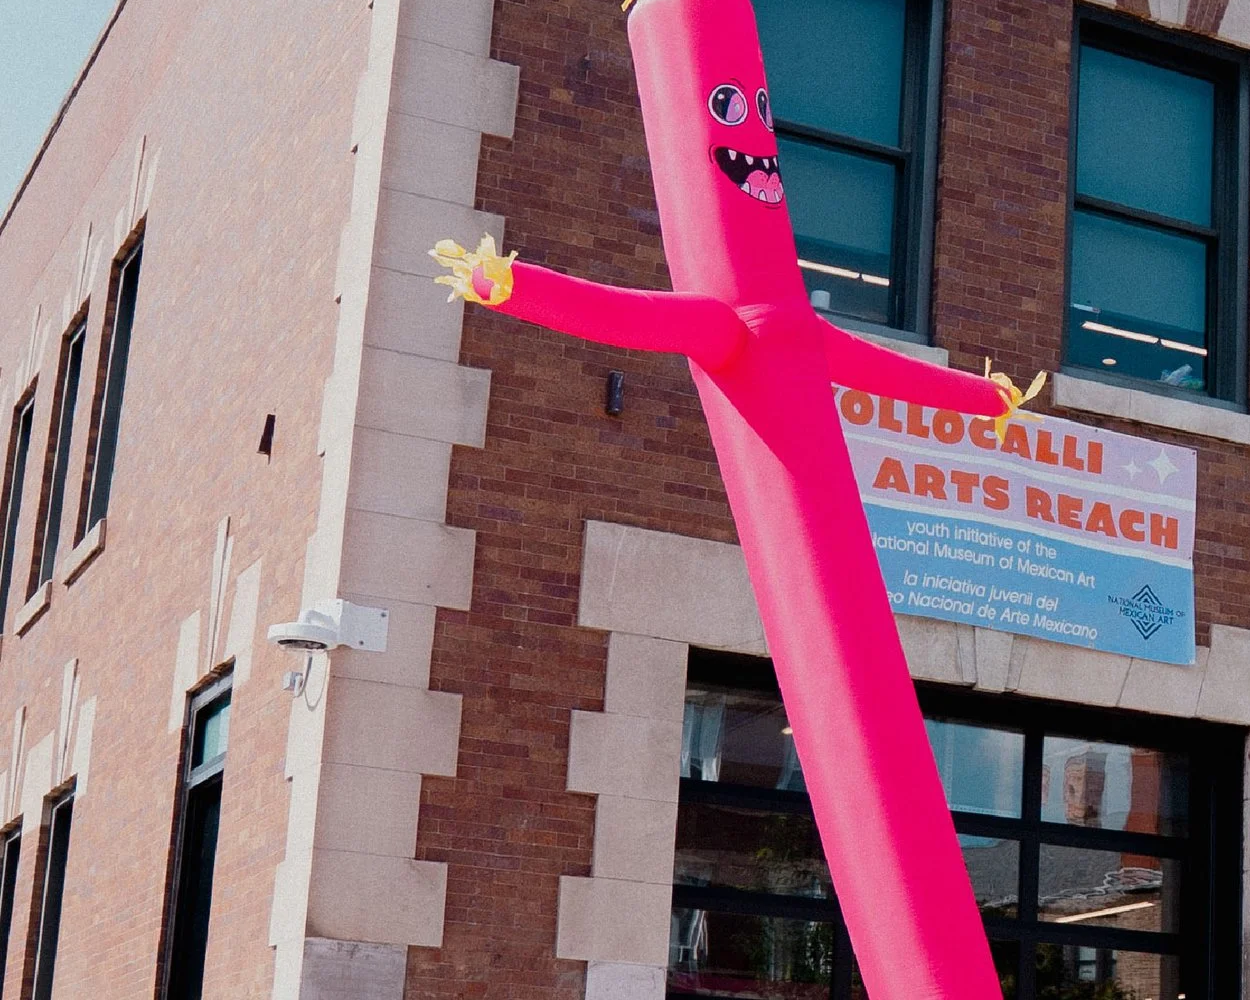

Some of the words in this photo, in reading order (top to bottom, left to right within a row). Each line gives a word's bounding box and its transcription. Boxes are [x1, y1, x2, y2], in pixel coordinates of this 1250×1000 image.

[832, 387, 1104, 475] OLLOCALLI
[872, 456, 1010, 511] ARTS
[1025, 485, 1180, 549] REACH
[906, 520, 950, 539] youth
[954, 525, 1013, 550] initiative
[1017, 539, 1031, 554] of
[1035, 541, 1057, 560] the
[934, 541, 995, 567] Museum
[999, 555, 1013, 570] of
[1017, 557, 1074, 584] Mexican
[1077, 571, 1096, 589] Art
[903, 569, 918, 586] la
[922, 572, 986, 597] iniciativa
[988, 584, 1033, 607] juvenil
[1036, 595, 1059, 612] del
[1107, 594, 1143, 611] NATIONAL
[1144, 603, 1174, 616] MUSEUM
[908, 591, 975, 615] Nacional
[977, 603, 997, 620] de
[1000, 607, 1030, 625] Arte
[1033, 613, 1098, 640] Mexicano
[1119, 606, 1155, 622] MEXICAN
[1157, 616, 1174, 625] ART
